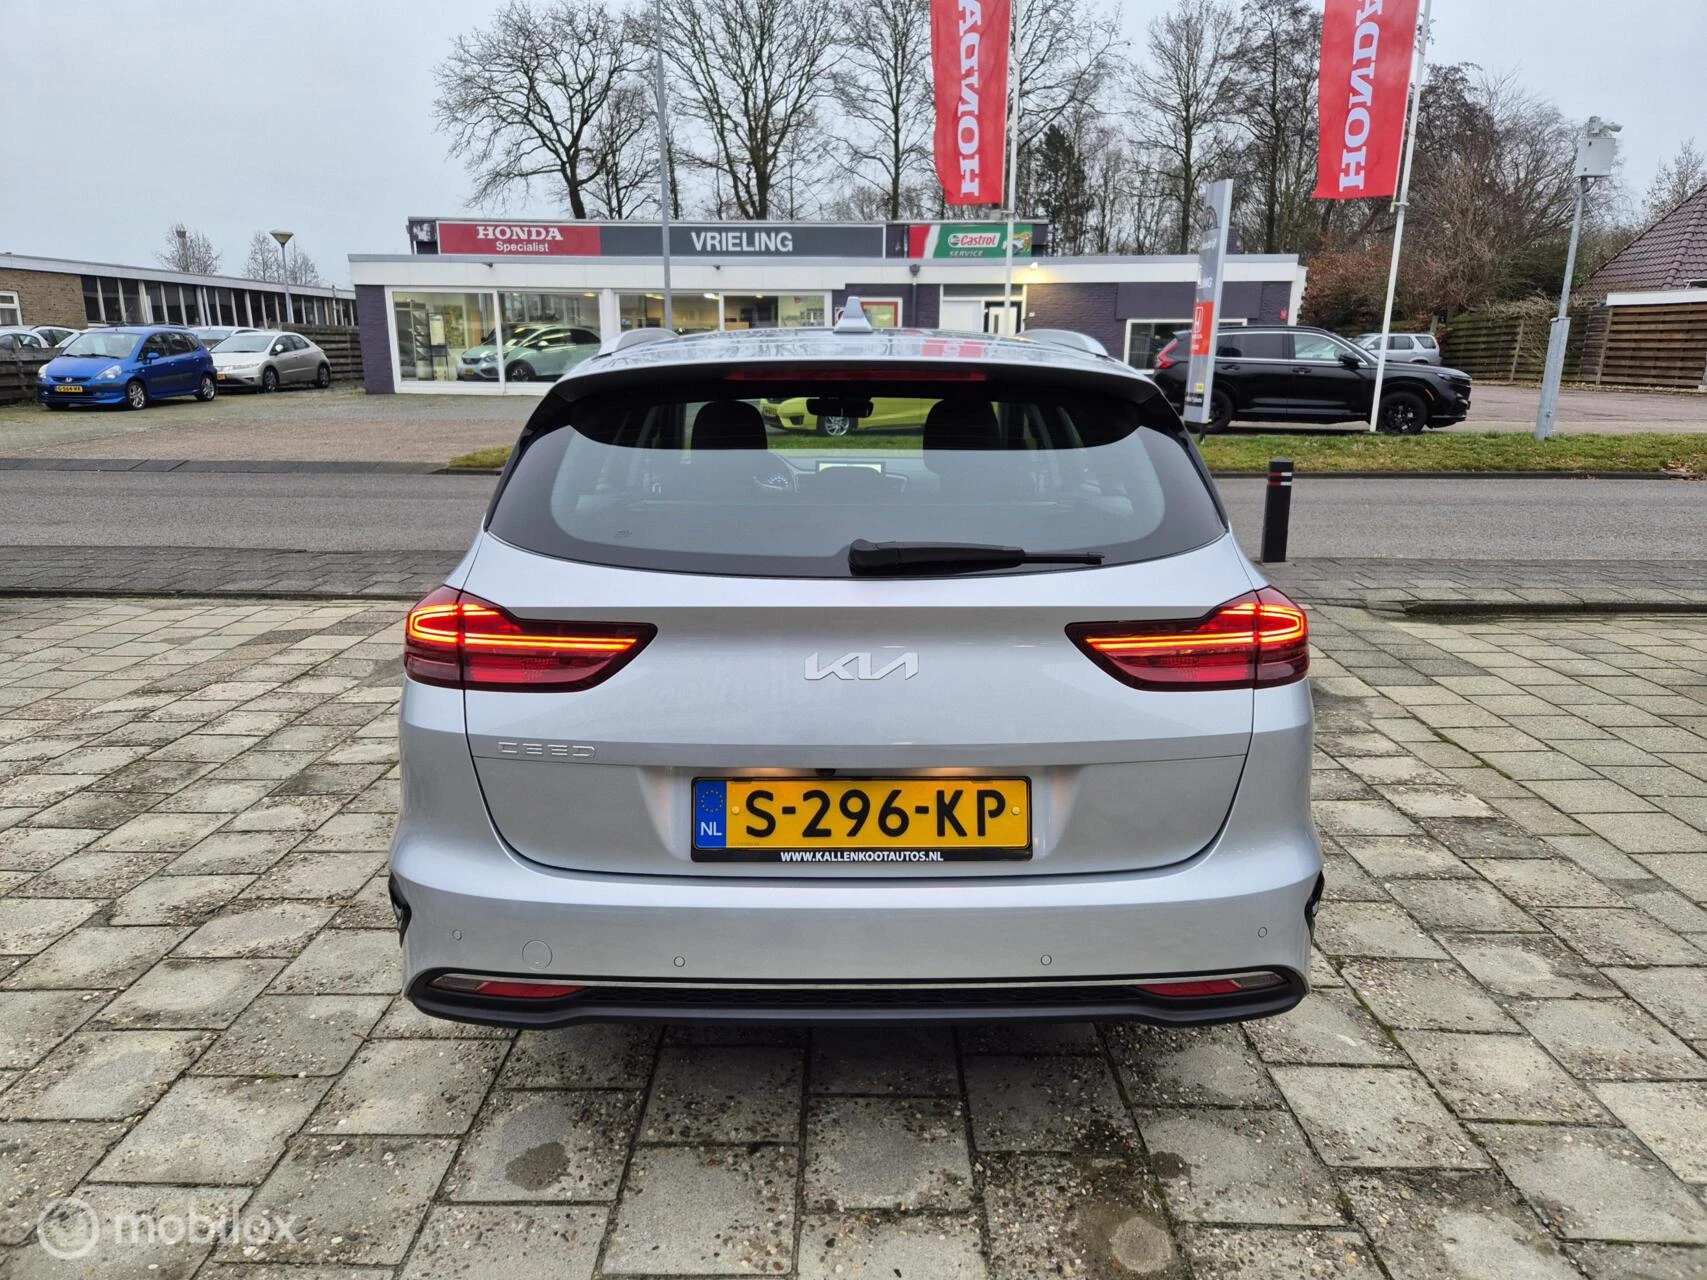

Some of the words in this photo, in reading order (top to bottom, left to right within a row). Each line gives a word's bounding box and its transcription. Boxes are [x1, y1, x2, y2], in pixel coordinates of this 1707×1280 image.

[476, 226, 564, 242] HONDA
[691, 231, 793, 252] VRIELING
[960, 235, 997, 246] Castrol
[495, 241, 549, 253] Specialist
[803, 652, 920, 681] KIA
[745, 788, 1006, 839] S-296-KP
[700, 821, 723, 836] NL
[780, 851, 945, 862] WWW.KALLENKOOTAUTOS.NL
